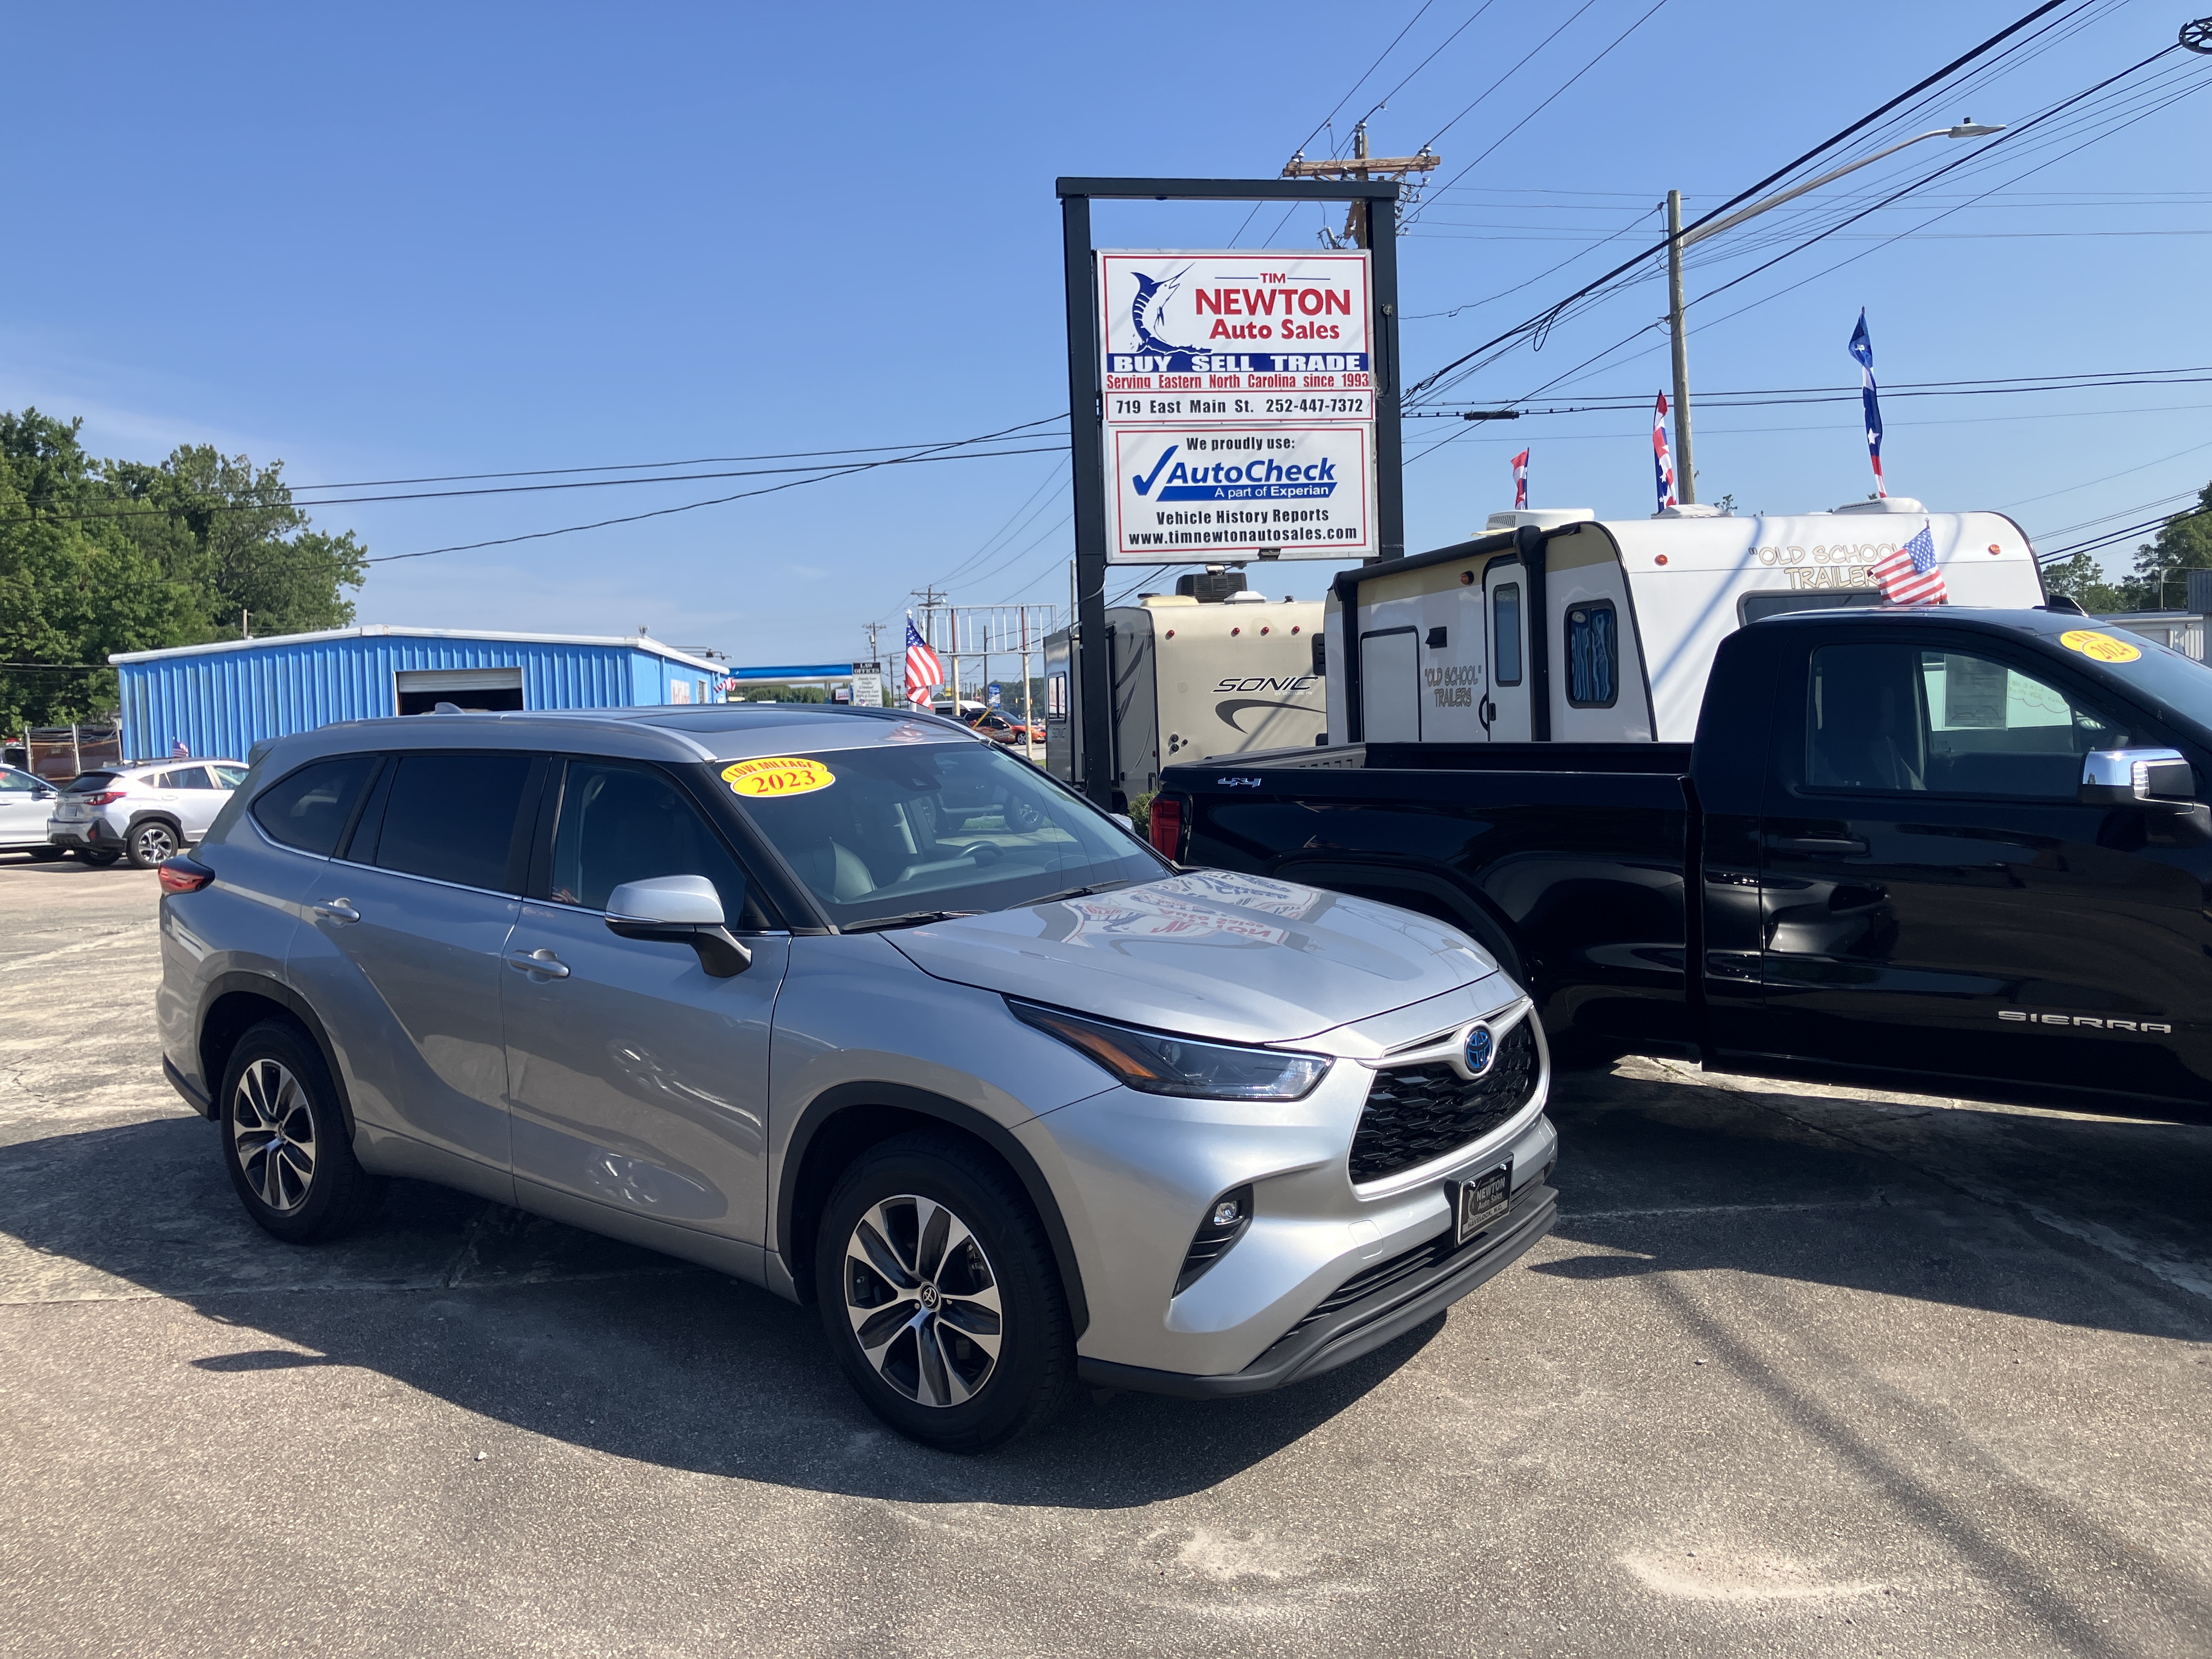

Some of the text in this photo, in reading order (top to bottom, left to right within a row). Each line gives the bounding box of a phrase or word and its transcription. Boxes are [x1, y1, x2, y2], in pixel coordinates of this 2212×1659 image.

[1260, 273, 1285, 284] TIM
[1195, 289, 1350, 315] NEWTON
[1209, 319, 1340, 340] Auto Sales
[1113, 355, 1361, 373] BUY SELL TRADE
[1107, 374, 1369, 388] Serving Eastern North Carolina since 1993
[1116, 399, 1363, 414] 719 East Main St. 252-447-7372
[1186, 437, 1295, 451] We proudly use:
[1166, 457, 1336, 484] AutoCheck
[1215, 486, 1329, 499] A part of Experian
[1156, 509, 1329, 525] Vehicle History Reports
[1128, 527, 1357, 545] www.timnewtonautosales.com
[1784, 566, 1881, 589] TRAILER
[2090, 641, 2132, 659] 2024
[1210, 676, 1319, 693] SONIC
[1434, 687, 1472, 707] TRAILERS
[727, 760, 814, 778] LOW MILEAGE
[752, 770, 815, 793] 2023
[1997, 1011, 2172, 1034] SIERRA
[1476, 1176, 1505, 1201] NEWTON
[1477, 1192, 1503, 1211] Auto Sales
